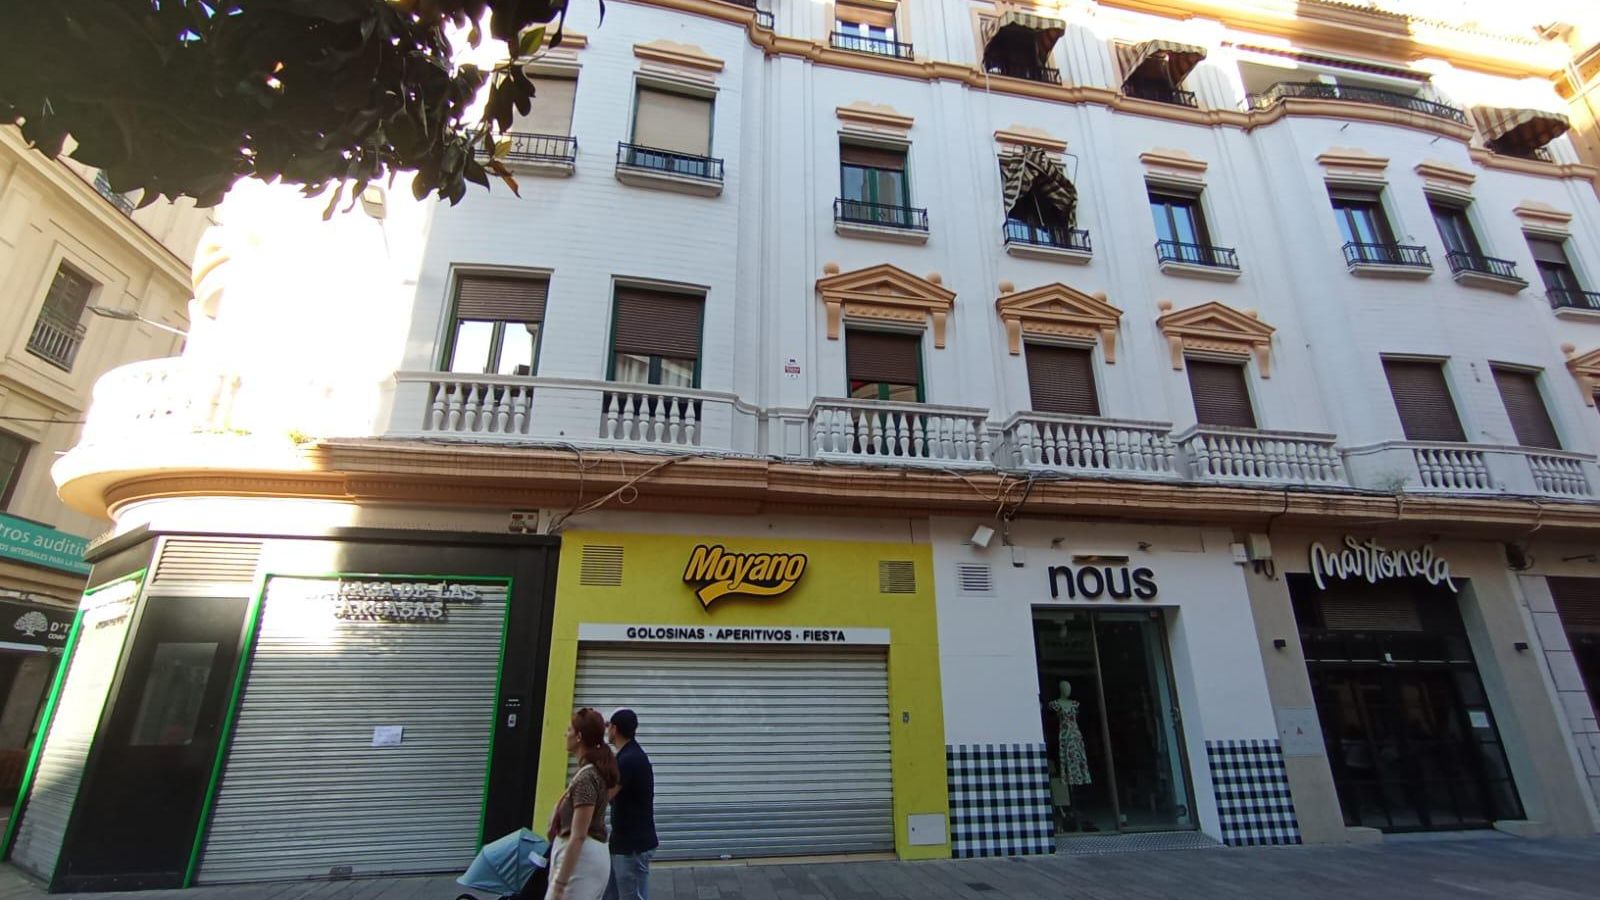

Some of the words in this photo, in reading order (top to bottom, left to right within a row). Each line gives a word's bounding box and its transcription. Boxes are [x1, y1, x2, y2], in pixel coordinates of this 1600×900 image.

[683, 545, 807, 591] Moyano
[1048, 566, 1158, 600] nous
[627, 626, 705, 640] GOLOSINAS
[716, 628, 792, 641] APERITIVOS
[803, 630, 846, 642] FIESTA
